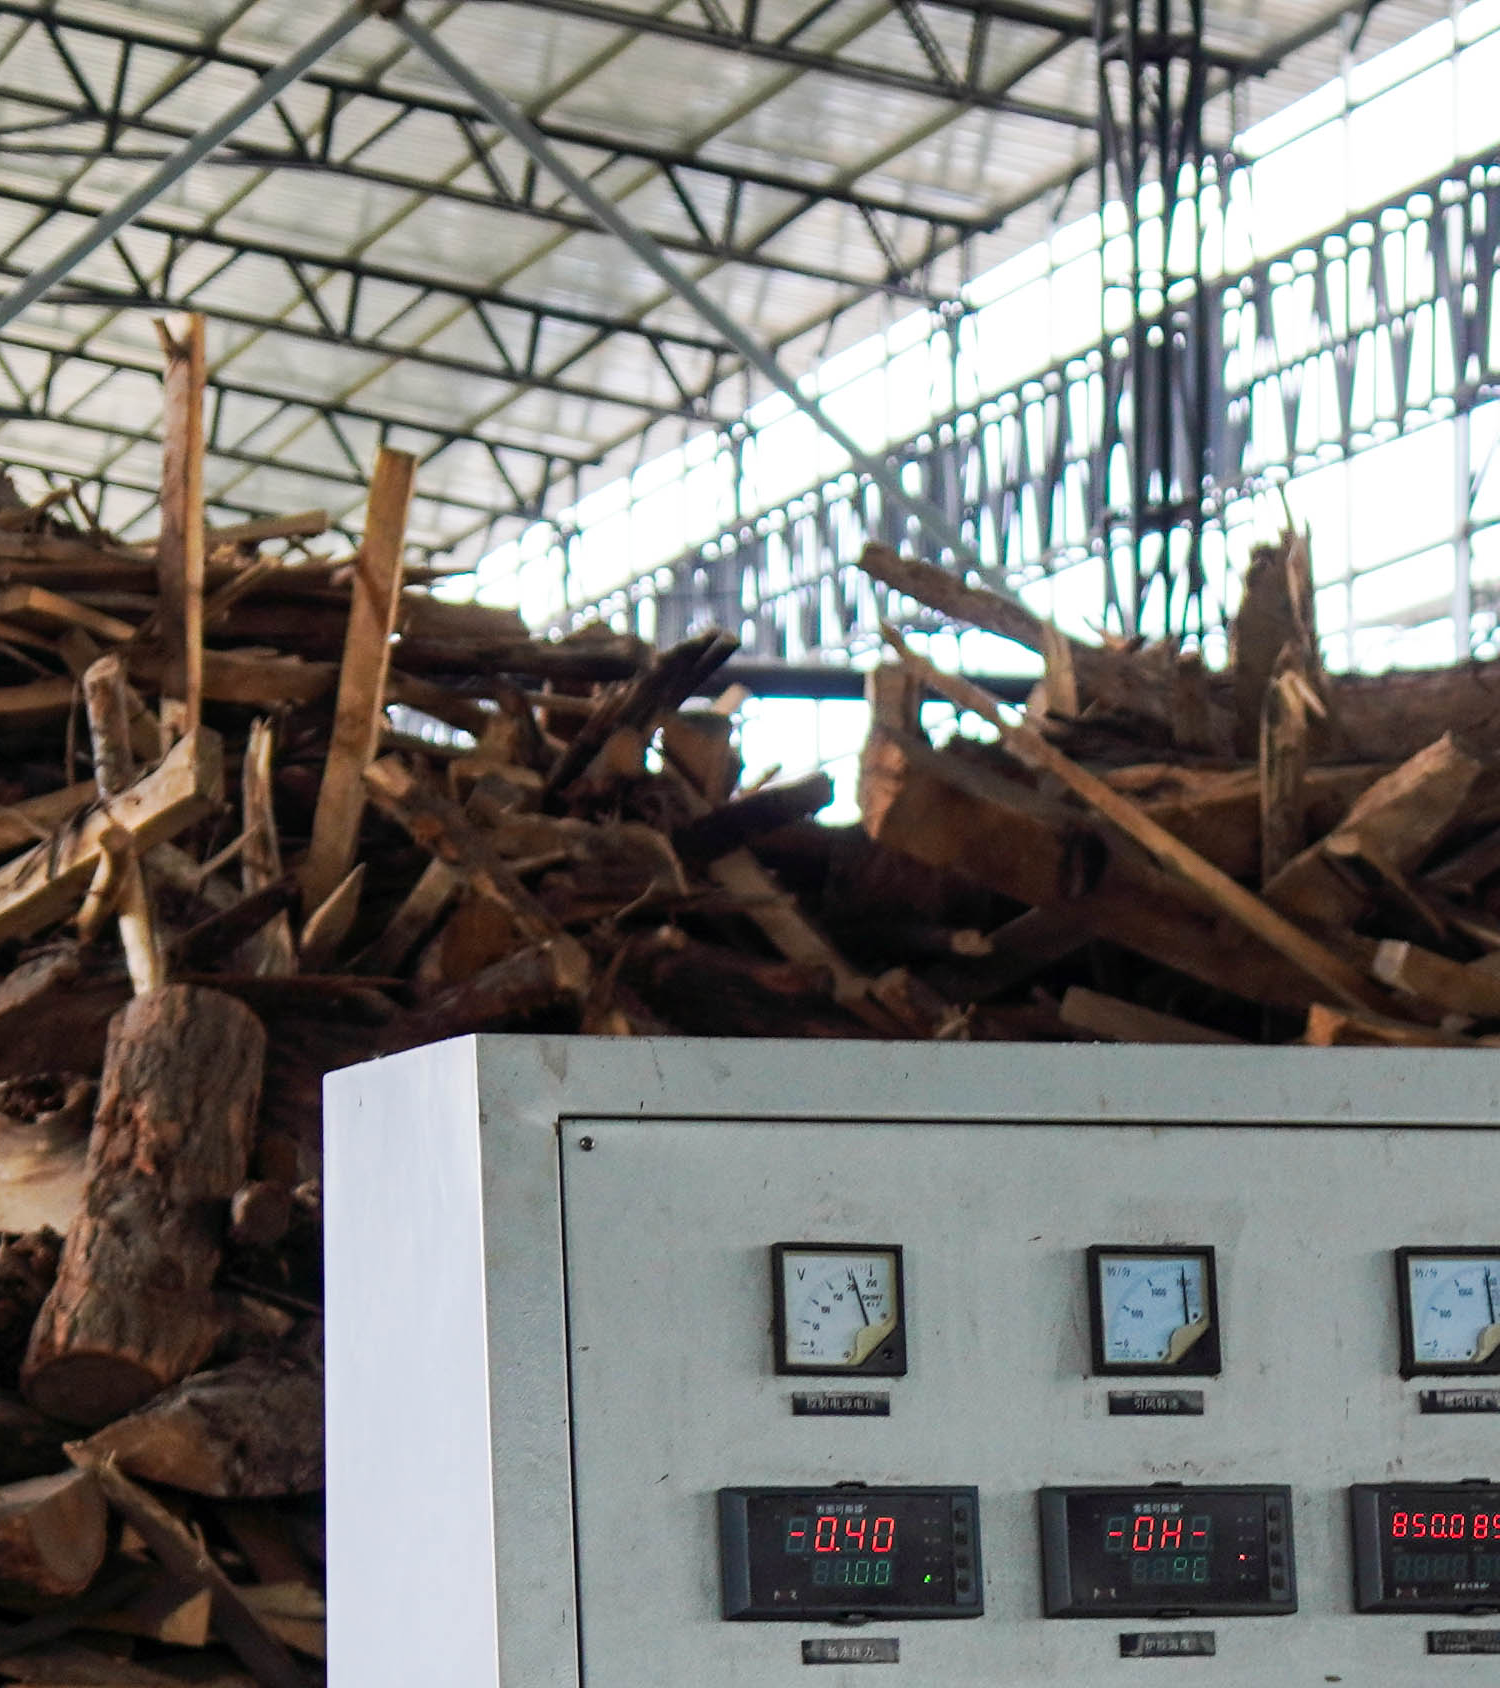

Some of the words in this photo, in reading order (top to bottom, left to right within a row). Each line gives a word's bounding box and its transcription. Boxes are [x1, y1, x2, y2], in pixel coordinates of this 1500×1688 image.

[797, 1267, 805, 1280] V
[788, 1516, 897, 1552] -0.40
[1392, 1512, 1465, 1538] 850.0
